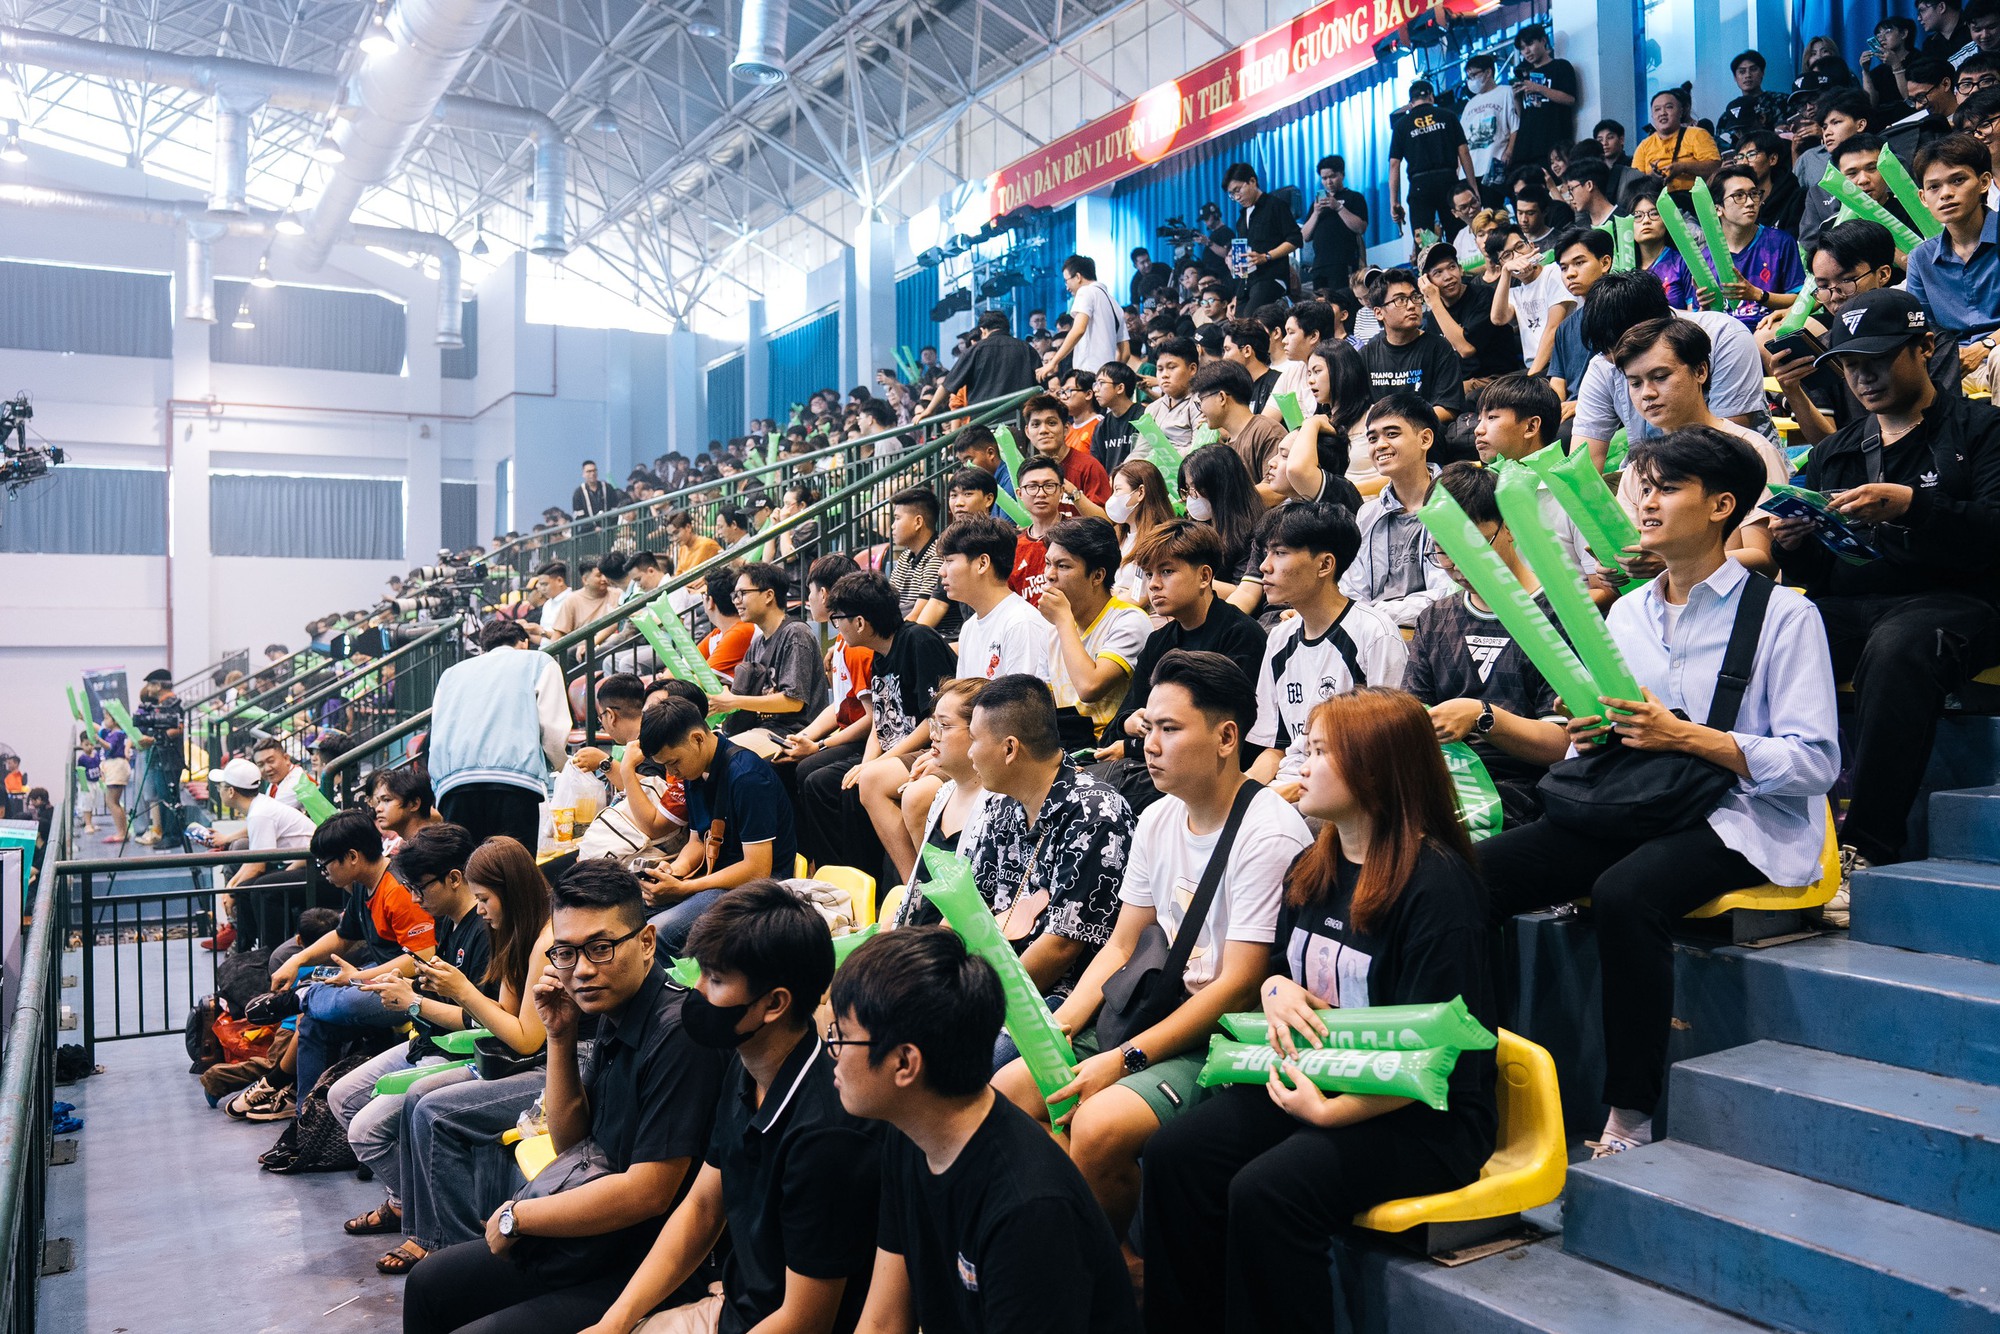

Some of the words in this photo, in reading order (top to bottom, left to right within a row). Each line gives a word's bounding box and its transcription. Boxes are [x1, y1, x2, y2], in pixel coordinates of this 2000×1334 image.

[997, 171, 1032, 214] TOÀN
[1034, 156, 1062, 197] DÂN
[1063, 141, 1093, 183] RÈN
[1237, 48, 1291, 102] THEO
[1292, 5, 1369, 74] GƯƠNG
[1413, 114, 1436, 129] GE
[1410, 122, 1446, 138] SECURITY
[1406, 376, 1421, 384] CUP
[1409, 369, 1423, 377] VUA
[1482, 638, 1503, 646] SPORTS
[1287, 682, 1303, 704] 69
[1231, 1046, 1332, 1076] ONINE
